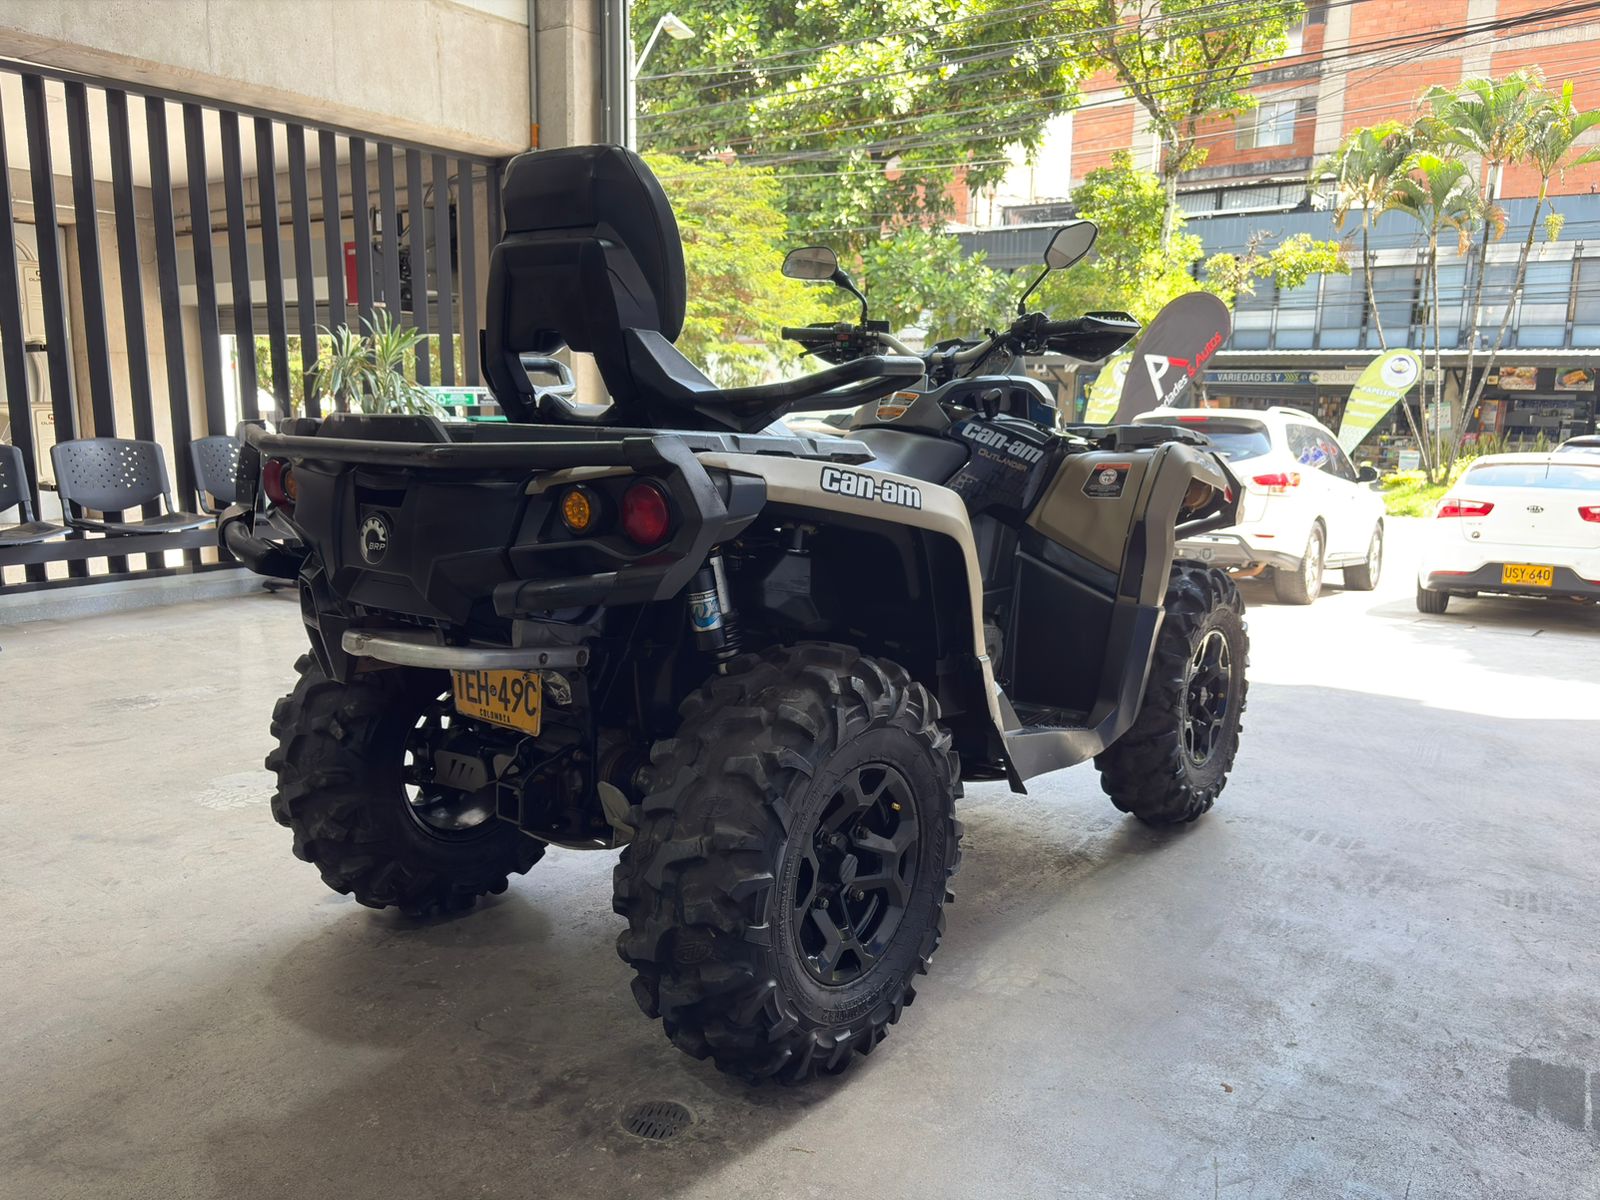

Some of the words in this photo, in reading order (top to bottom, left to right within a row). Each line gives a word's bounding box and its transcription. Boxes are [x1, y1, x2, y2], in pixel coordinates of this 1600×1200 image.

[1162, 374, 1189, 407] dades
[1196, 331, 1223, 368] Autos
[1217, 373, 1272, 383] VARIEDADES
[1273, 373, 1281, 383] Y
[961, 422, 1044, 464] can-am
[978, 447, 1028, 472] OUTLANDER
[821, 467, 922, 509] can-am
[368, 541, 386, 551] BRP
[1504, 567, 1526, 579] USY
[1529, 569, 1551, 581] 640
[498, 676, 537, 716] 49C
